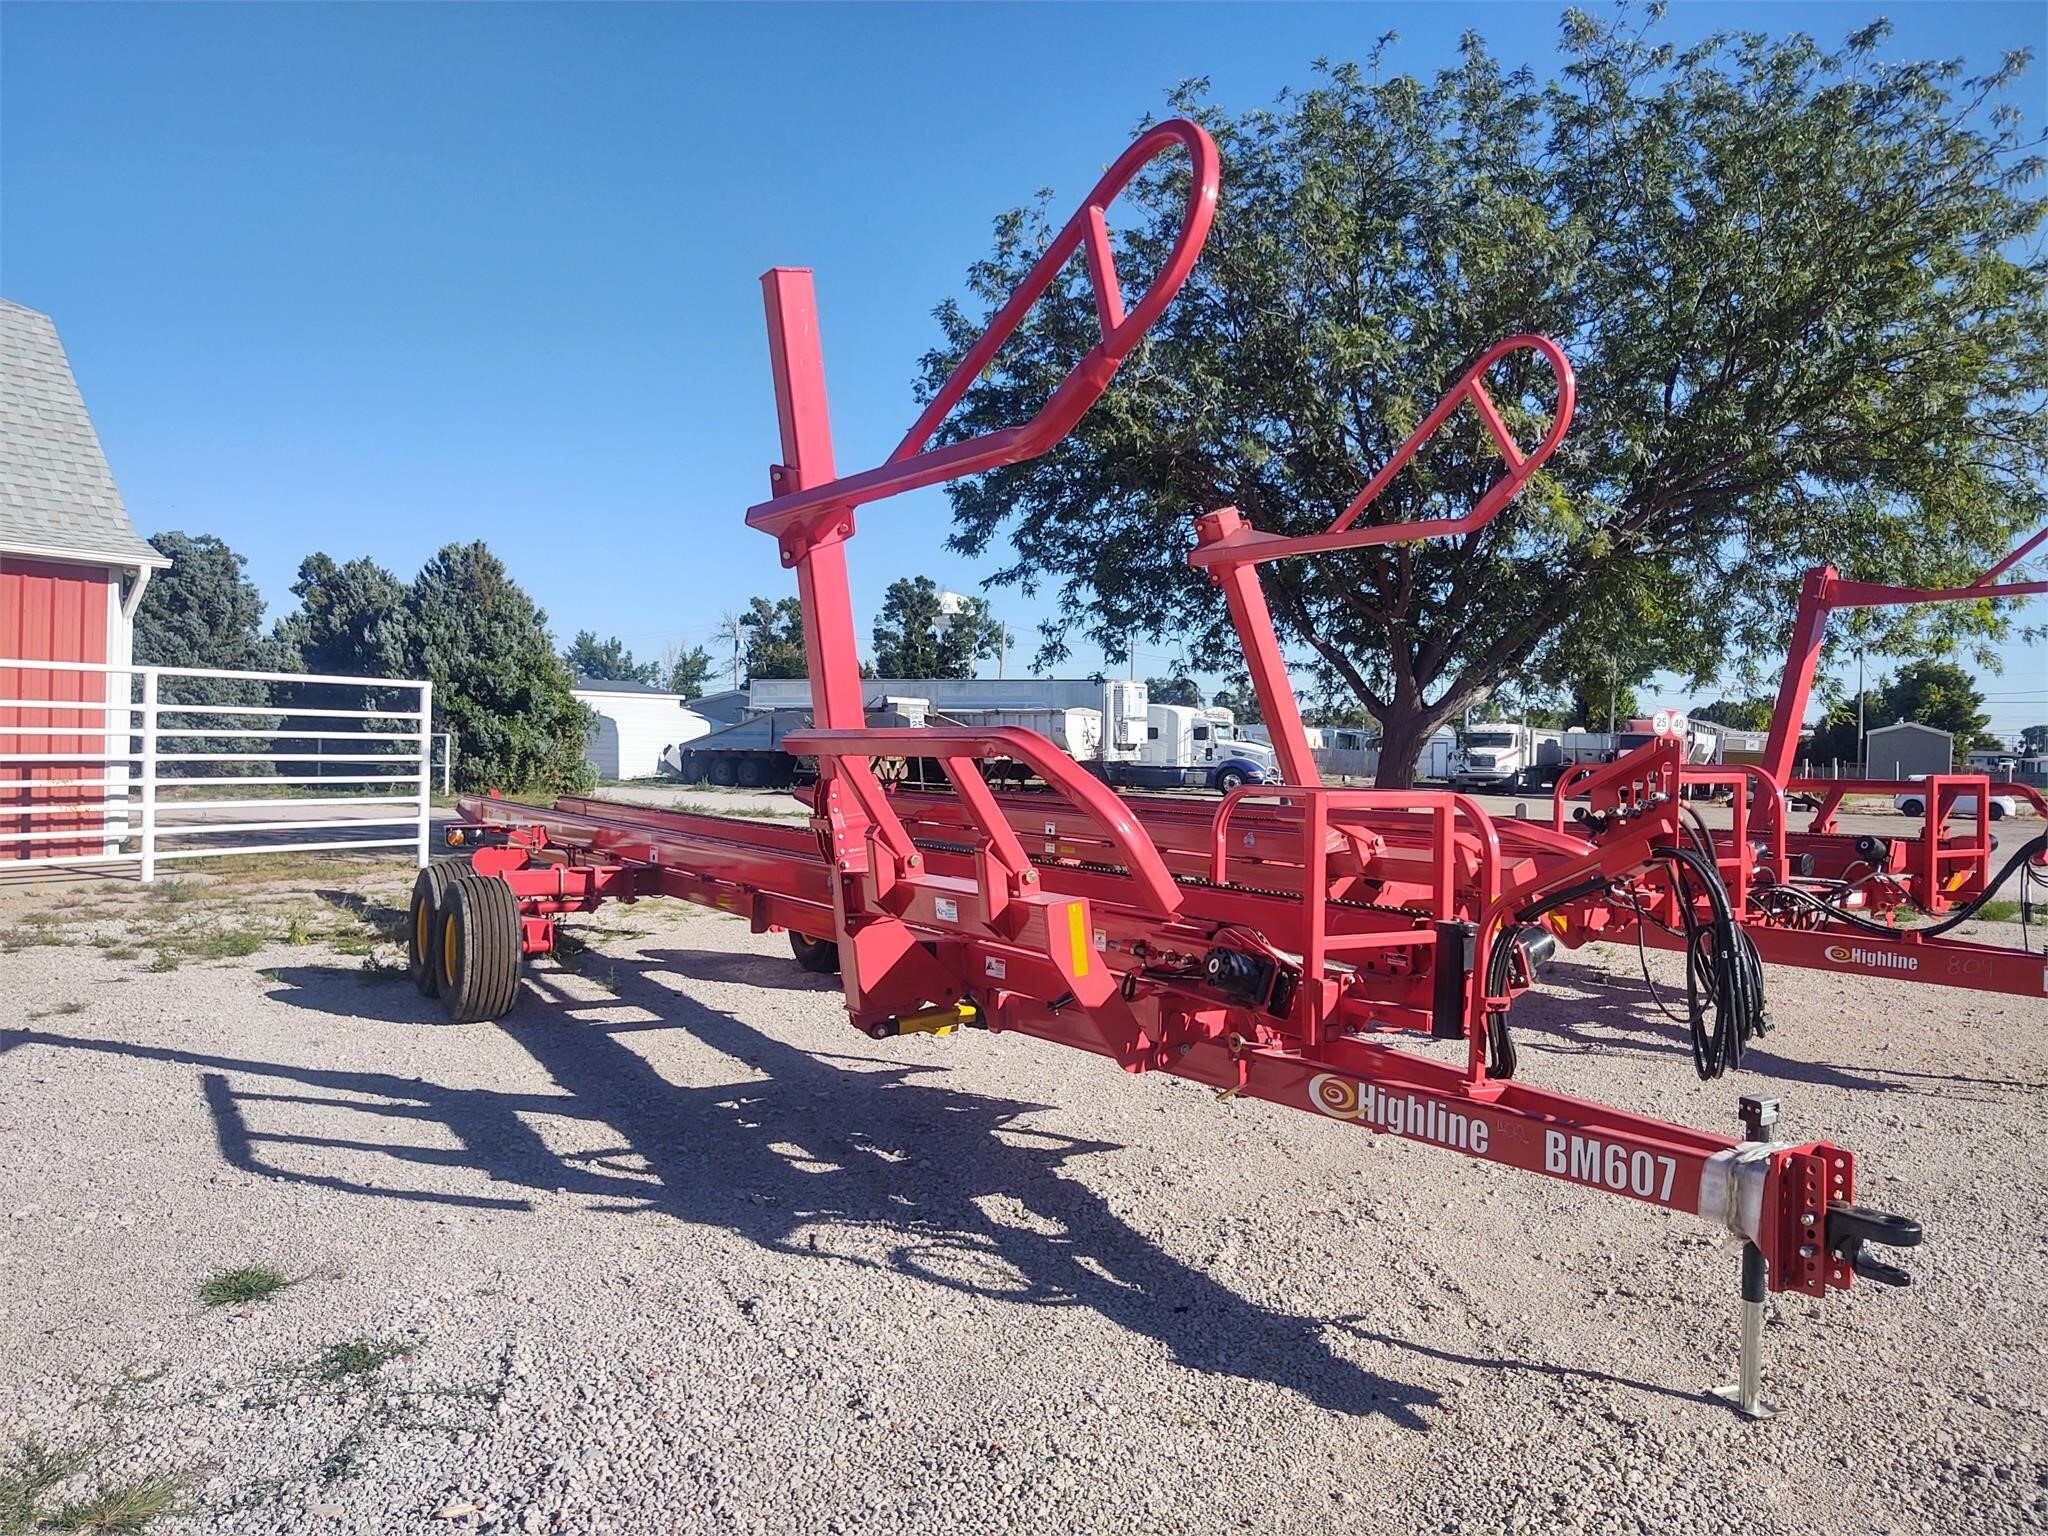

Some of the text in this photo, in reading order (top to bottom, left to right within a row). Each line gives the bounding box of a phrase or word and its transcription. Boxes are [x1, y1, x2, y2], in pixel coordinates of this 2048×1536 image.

[1656, 717, 1667, 728] 25
[1673, 719, 1684, 729] 40
[1851, 947, 1918, 970] Highline
[1357, 1082, 1489, 1154] Highline
[1545, 1129, 1677, 1202] BM607
